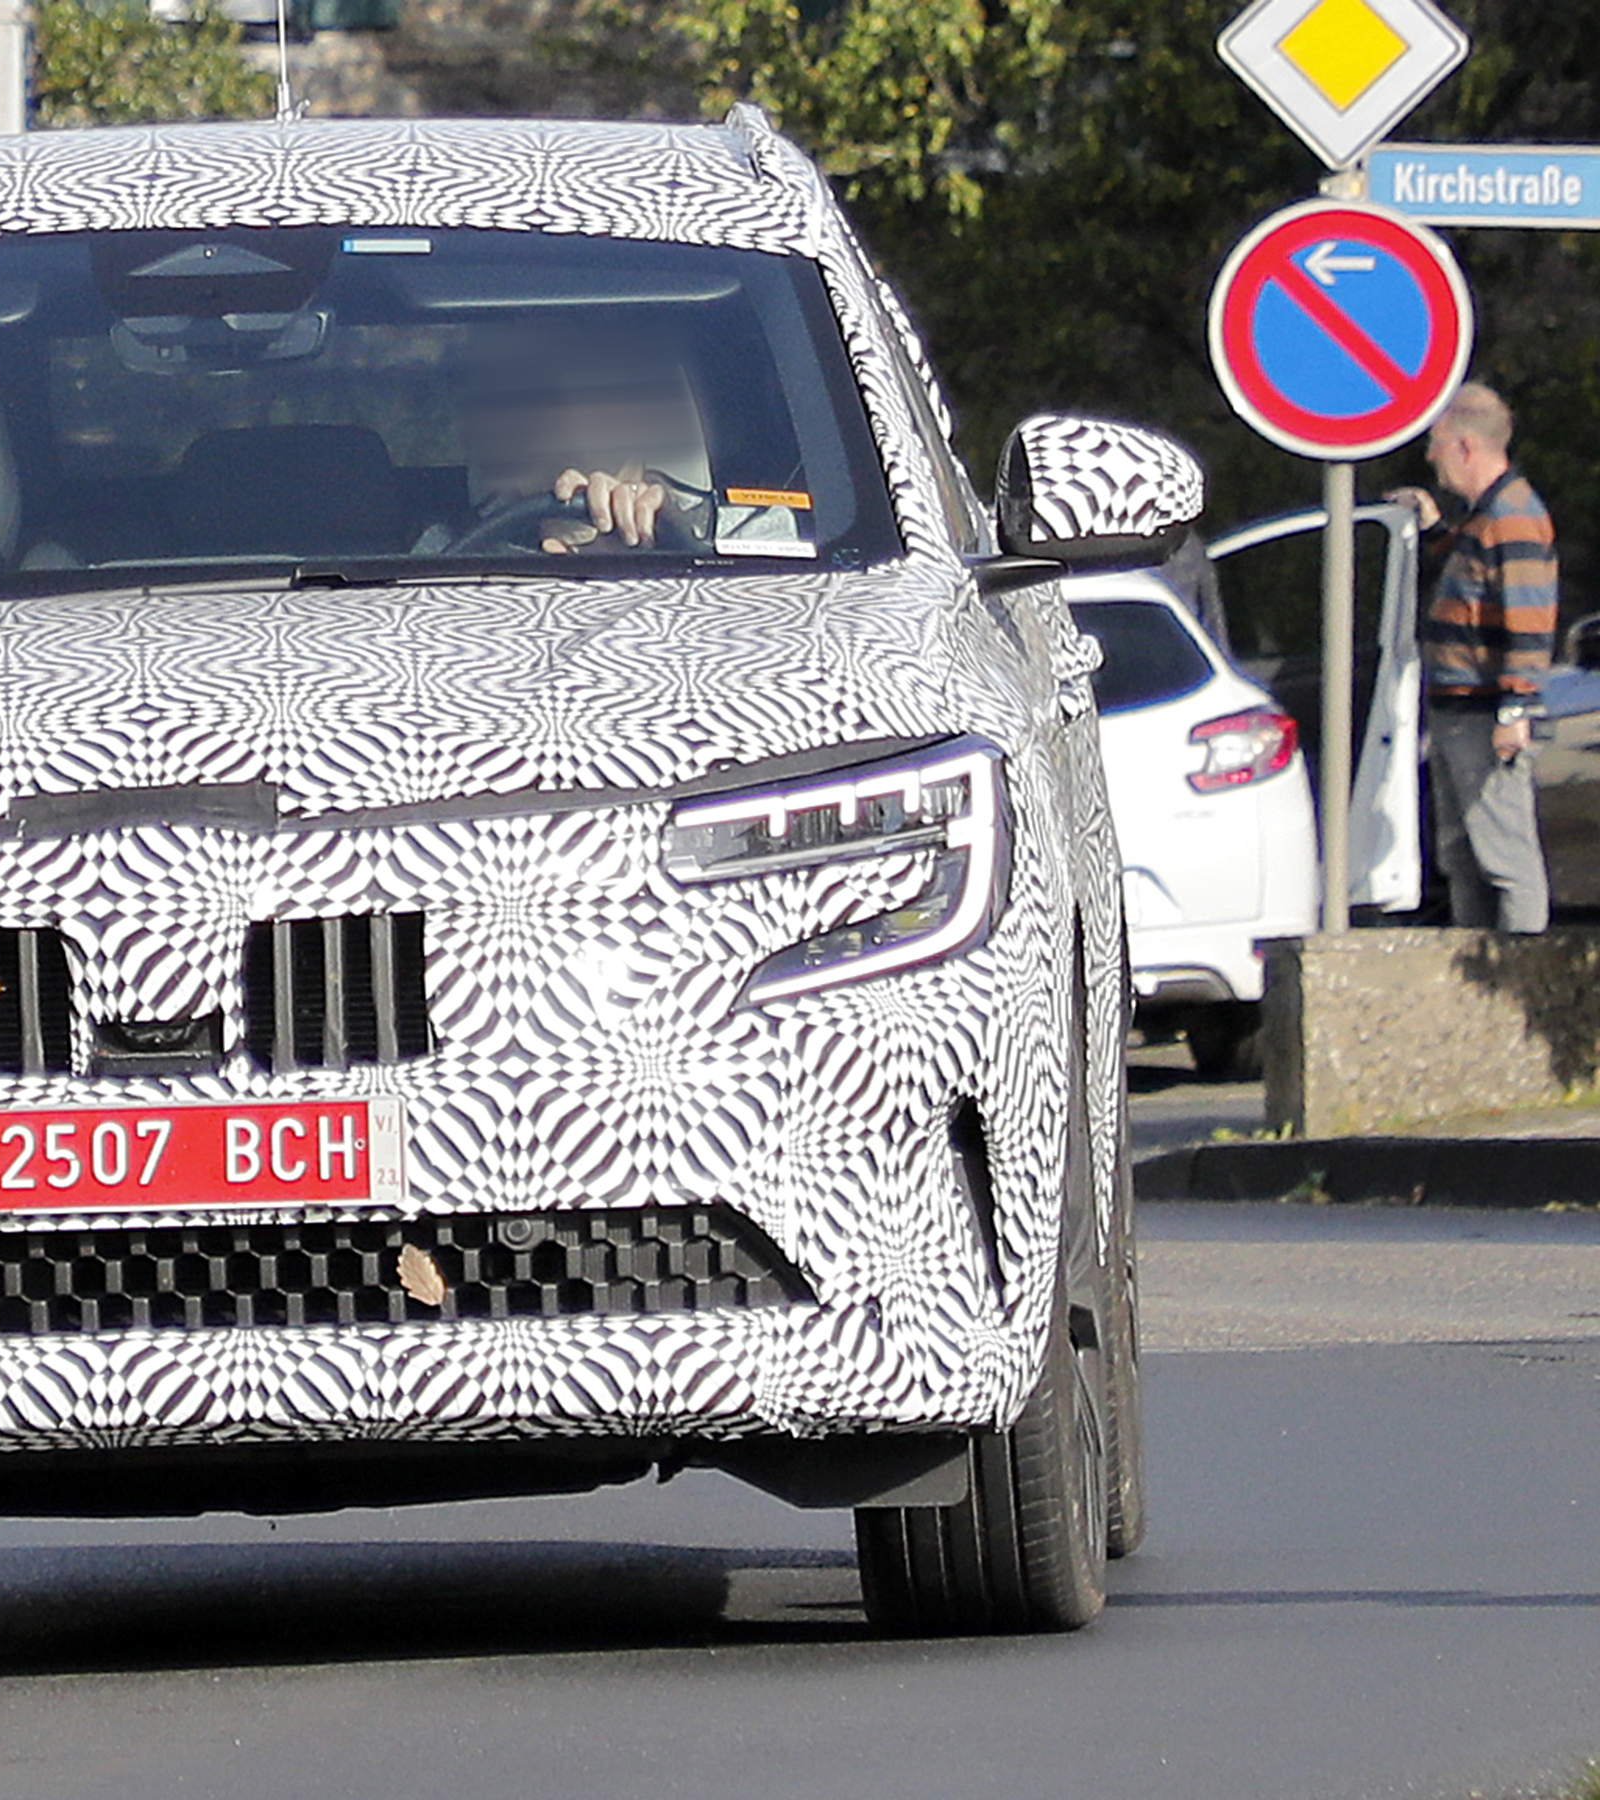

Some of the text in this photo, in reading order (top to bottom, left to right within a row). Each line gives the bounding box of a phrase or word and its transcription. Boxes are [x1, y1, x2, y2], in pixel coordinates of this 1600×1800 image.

[1394, 162, 1582, 206] Kirchstraße
[0, 1118, 172, 1190] 2507
[225, 1115, 356, 1184] BCH
